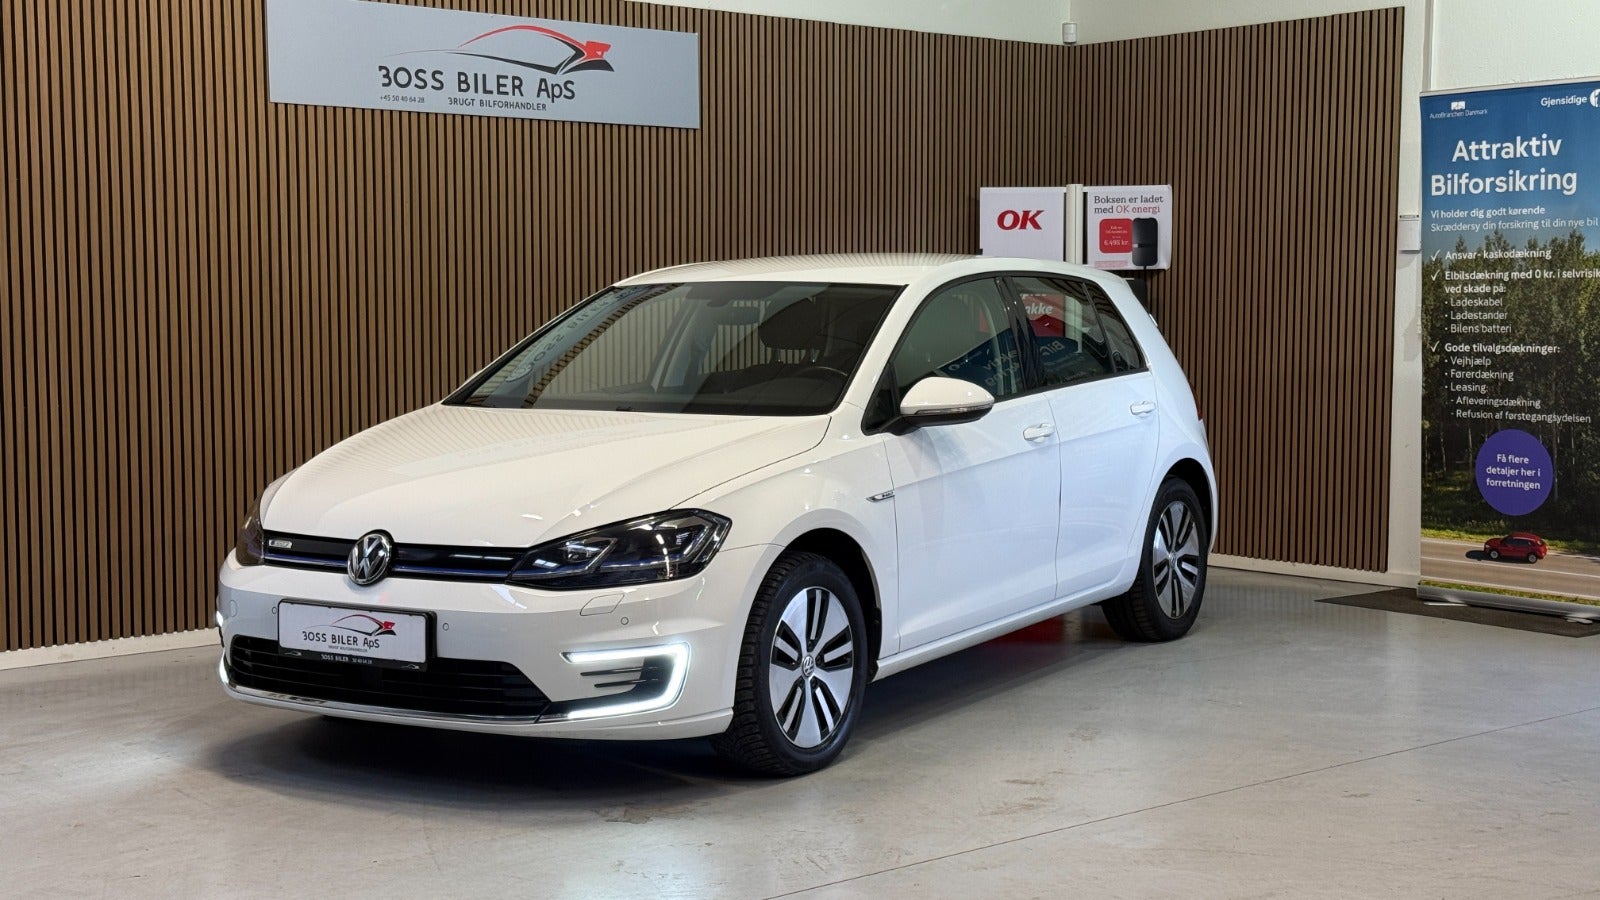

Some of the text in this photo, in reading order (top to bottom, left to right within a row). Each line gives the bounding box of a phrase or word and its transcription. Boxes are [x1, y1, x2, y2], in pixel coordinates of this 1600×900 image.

[457, 71, 524, 97] BILER
[536, 77, 576, 103] ApS
[479, 99, 547, 111] BILFORHANDLER
[1540, 95, 1588, 108] Gjensidige
[1452, 133, 1562, 162] Attraktiv
[1431, 168, 1577, 196] Bilforsikring
[1094, 196, 1126, 204] Boksen
[1140, 195, 1164, 203] ladet
[1094, 205, 1160, 215] med OK energi
[1430, 206, 1545, 219] Vi holder dig godt kørende
[997, 210, 1044, 231] OK
[1431, 217, 1598, 232] Skræddersy din forsikring til din nye bil
[1484, 250, 1552, 260] kaskodækning
[1445, 271, 1509, 281] Elbilsdækning
[1511, 270, 1532, 279] med
[1534, 269, 1542, 279] 0
[1543, 269, 1556, 279] kr.
[1562, 268, 1600, 279] selvrisik
[1445, 284, 1506, 294] ved skade på:
[1450, 298, 1503, 307] Ladeskabel
[1450, 311, 1508, 320] Ladestander
[1450, 324, 1512, 333] Bilens batteri
[1444, 342, 1560, 355] Gode tilvalgsdækninger:
[1450, 356, 1491, 367] Vejhjælp
[1450, 369, 1514, 382] Førerdækning
[1456, 396, 1541, 409] Afleveringsdækning
[1456, 409, 1591, 424] Refusion af førstegangsydelsen
[1497, 454, 1529, 464] Få flere
[1486, 466, 1519, 477] detaljer
[1521, 468, 1536, 477] her
[1486, 478, 1540, 490] forretningen
[331, 634, 358, 646] BILER
[363, 638, 380, 649] ApS
